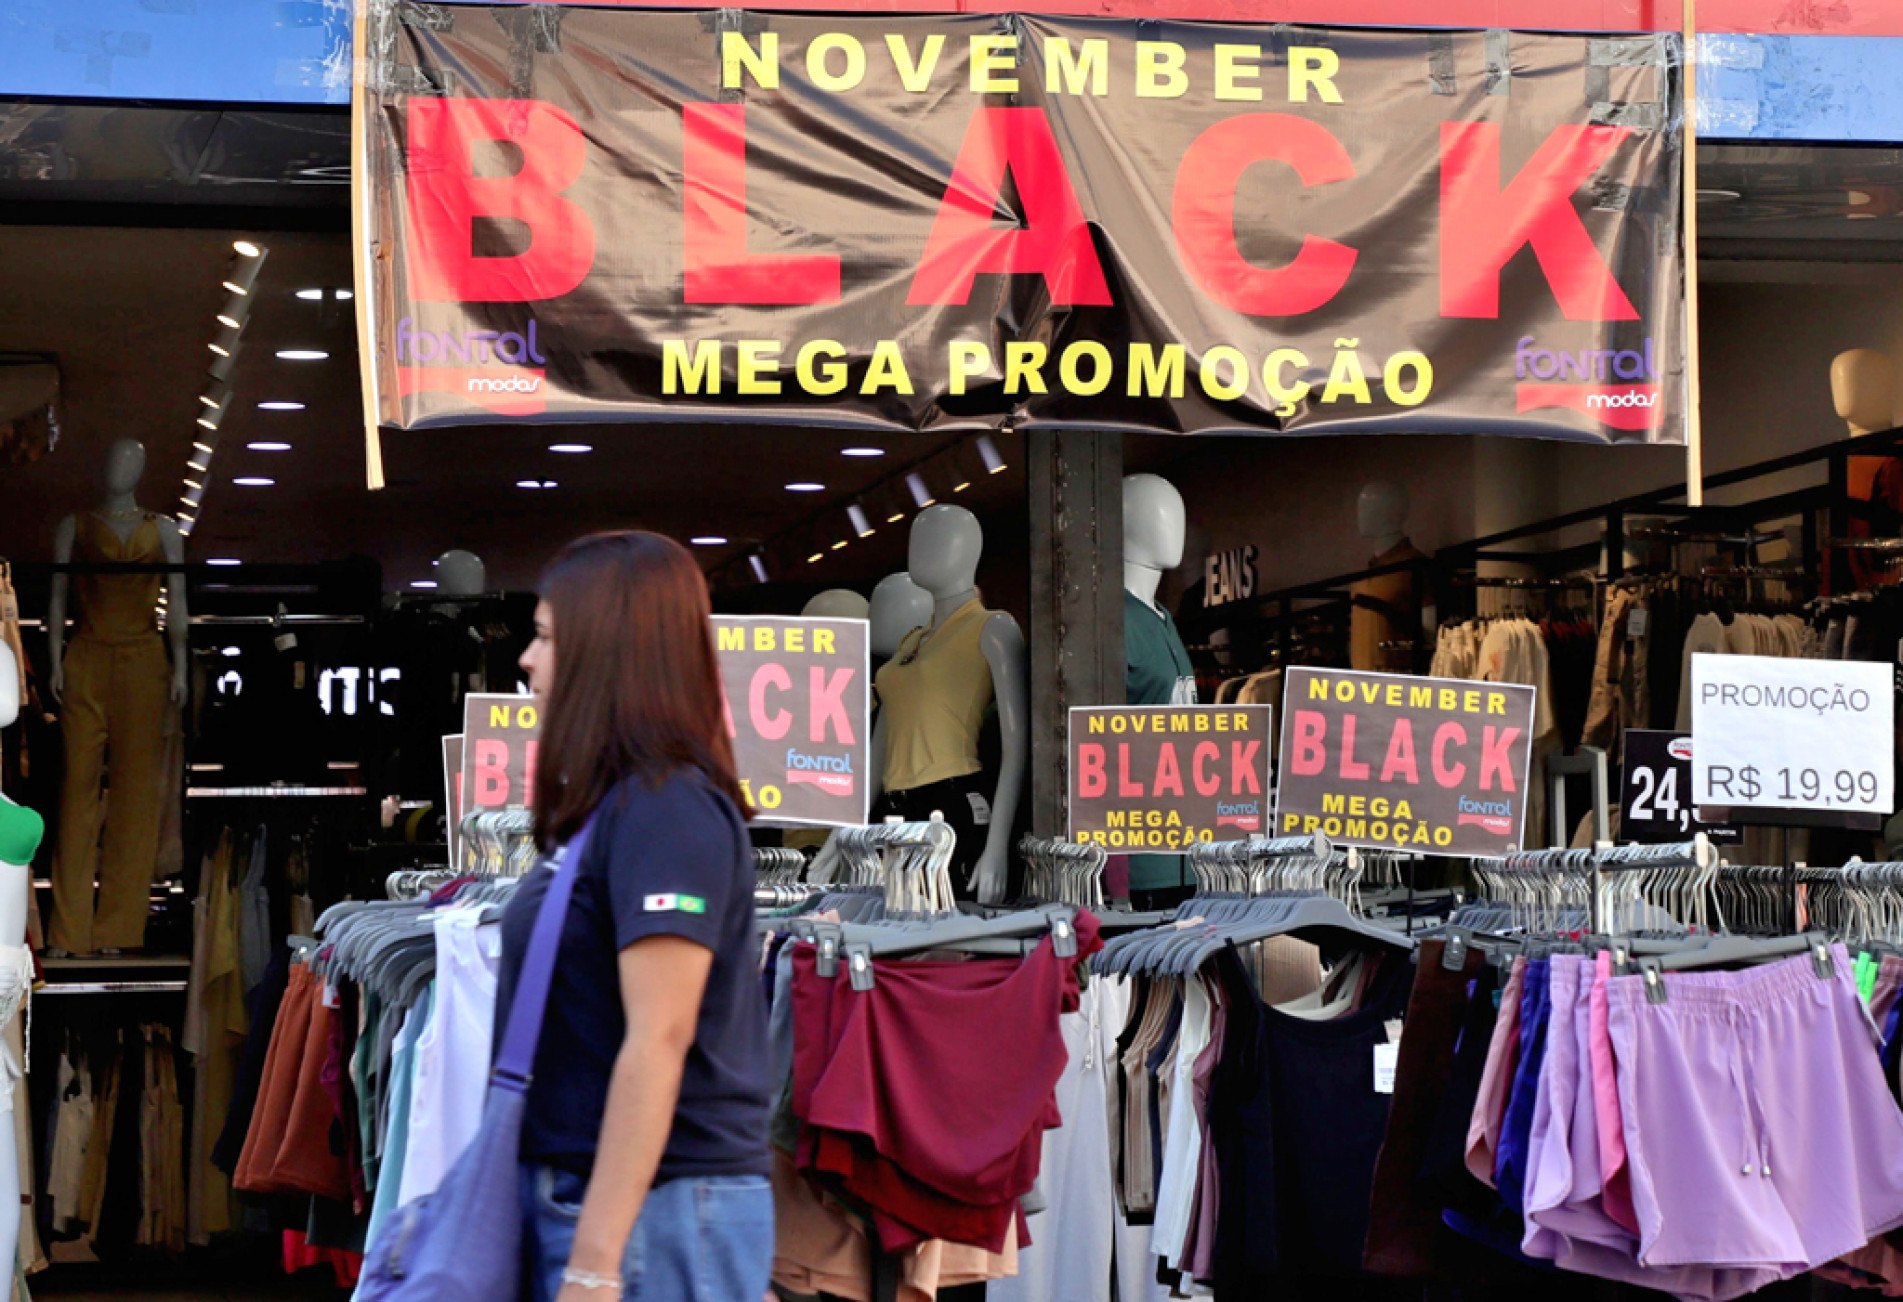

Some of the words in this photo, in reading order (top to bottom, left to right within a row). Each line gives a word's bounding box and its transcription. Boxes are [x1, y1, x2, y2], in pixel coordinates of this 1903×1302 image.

[721, 32, 1344, 103] NOVEMBER
[406, 96, 1641, 321] BLACK
[467, 374, 541, 393] modas
[661, 339, 914, 395] MEGA
[948, 338, 1434, 417] PROMOÇÃO
[1586, 390, 1657, 408] modas
[1308, 677, 1507, 715] NOVEMBER
[1701, 683, 1870, 715] PROMOÇÃO
[1088, 713, 1250, 734] NOVEMBER
[1290, 709, 1521, 793] BLACK
[1078, 740, 1261, 798] BLACK
[1706, 763, 1762, 801] R$
[1777, 766, 1877, 806] 19,99
[1106, 809, 1182, 828] MEGA
[1321, 792, 1414, 820] MEGA
[1076, 825, 1214, 850] PROMOÇÃO
[1283, 813, 1453, 847] PROMOÇÃO
